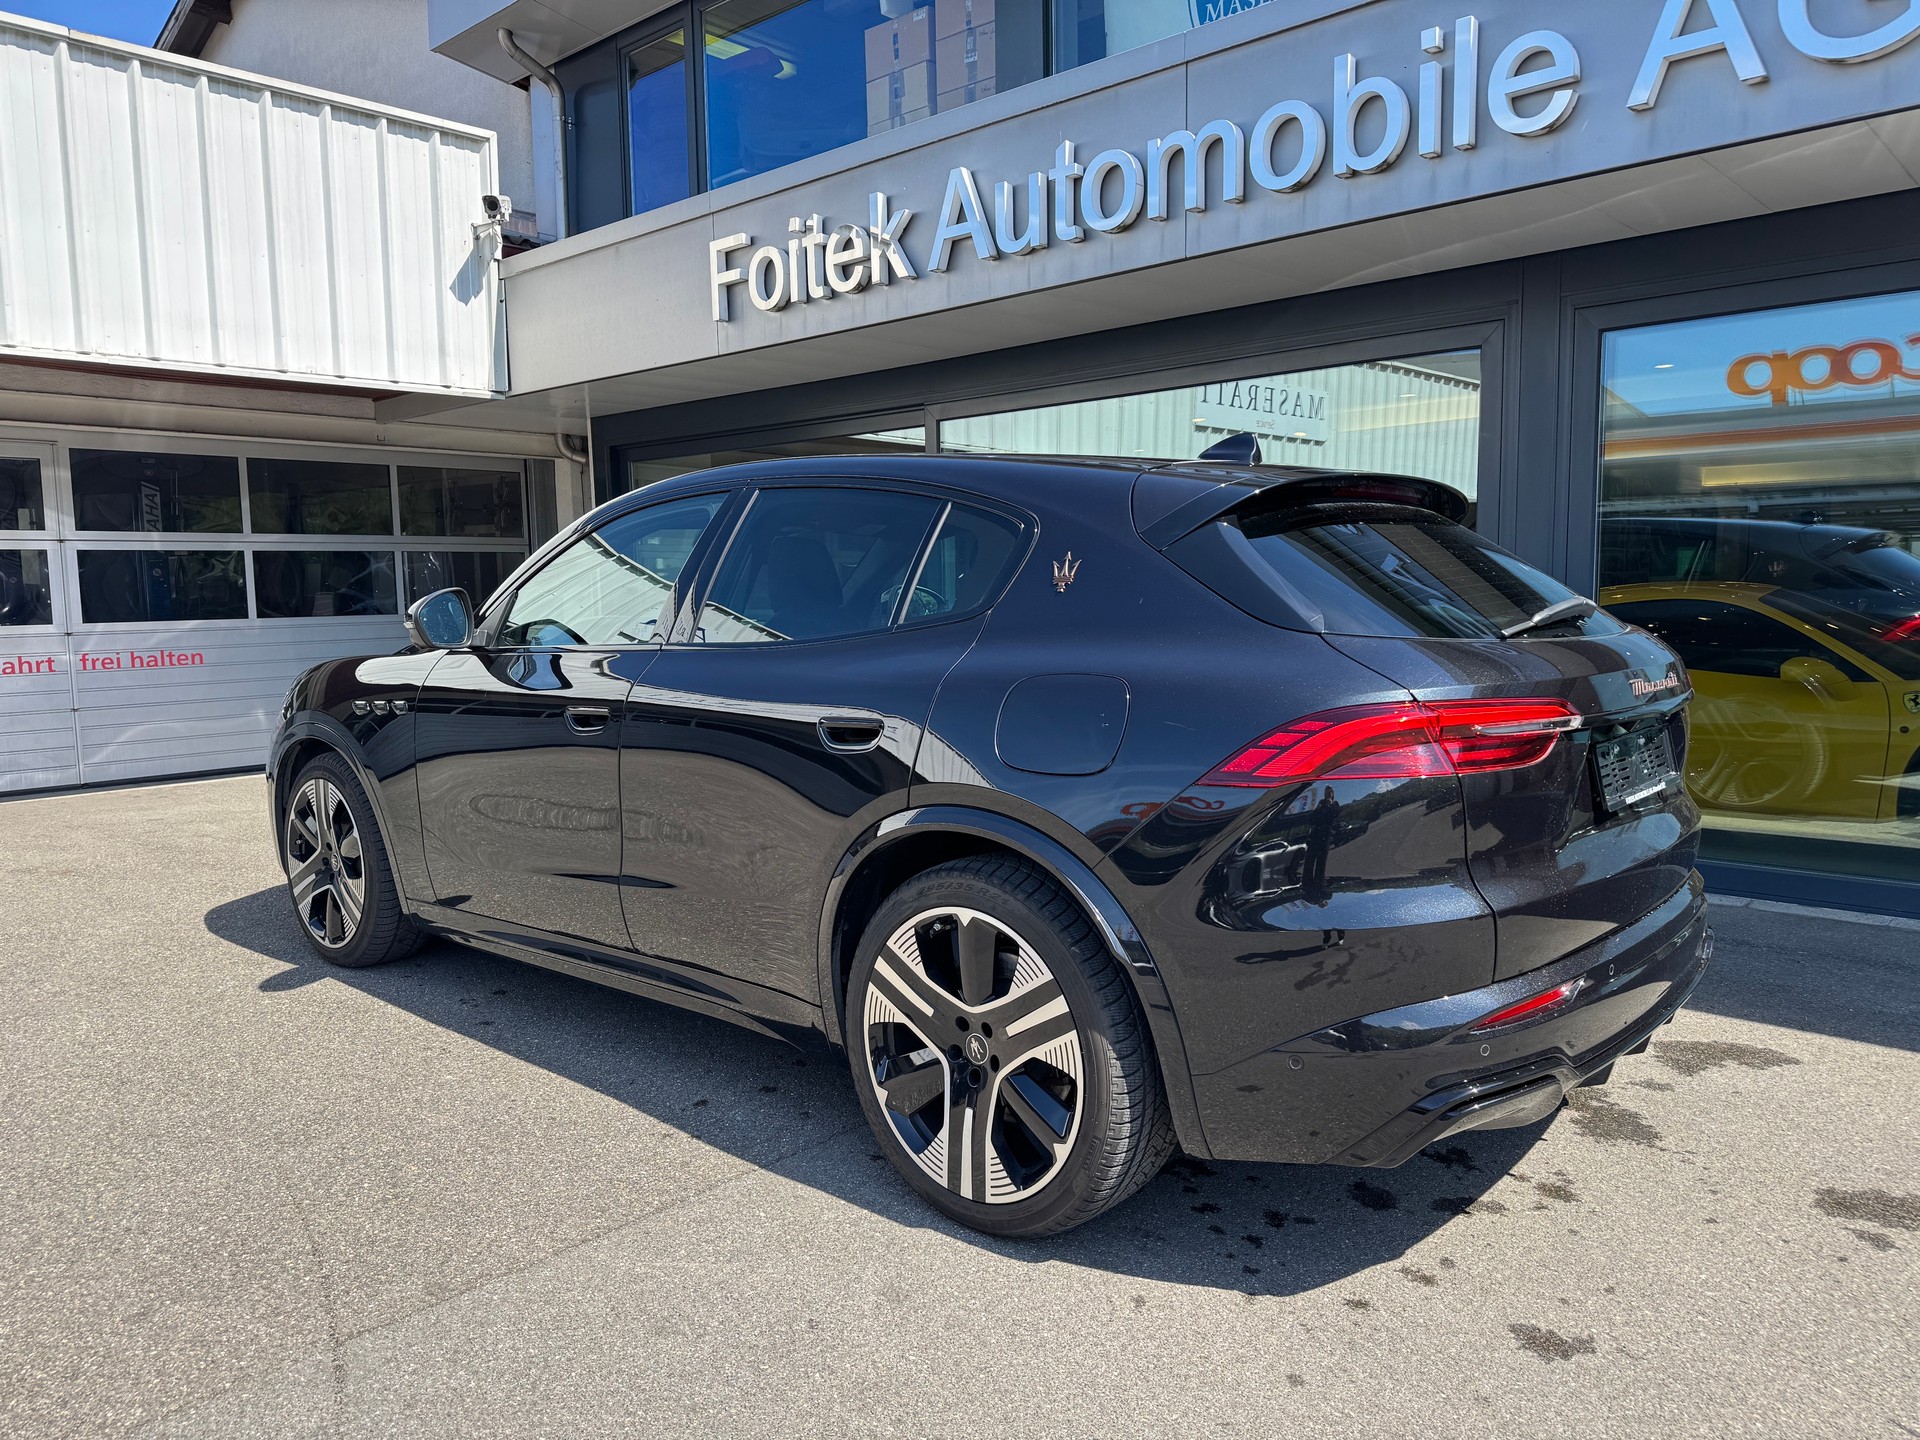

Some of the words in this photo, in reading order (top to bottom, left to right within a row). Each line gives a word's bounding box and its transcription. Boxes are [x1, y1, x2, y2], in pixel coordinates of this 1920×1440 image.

[1204, 0, 1277, 23] MAS
[709, 191, 918, 322] Foitek
[927, 15, 1580, 274] Automobile
[144, 493, 160, 532] AHA
[1, 656, 56, 675] ahrt
[79, 652, 122, 671] frei
[130, 650, 204, 669] halten
